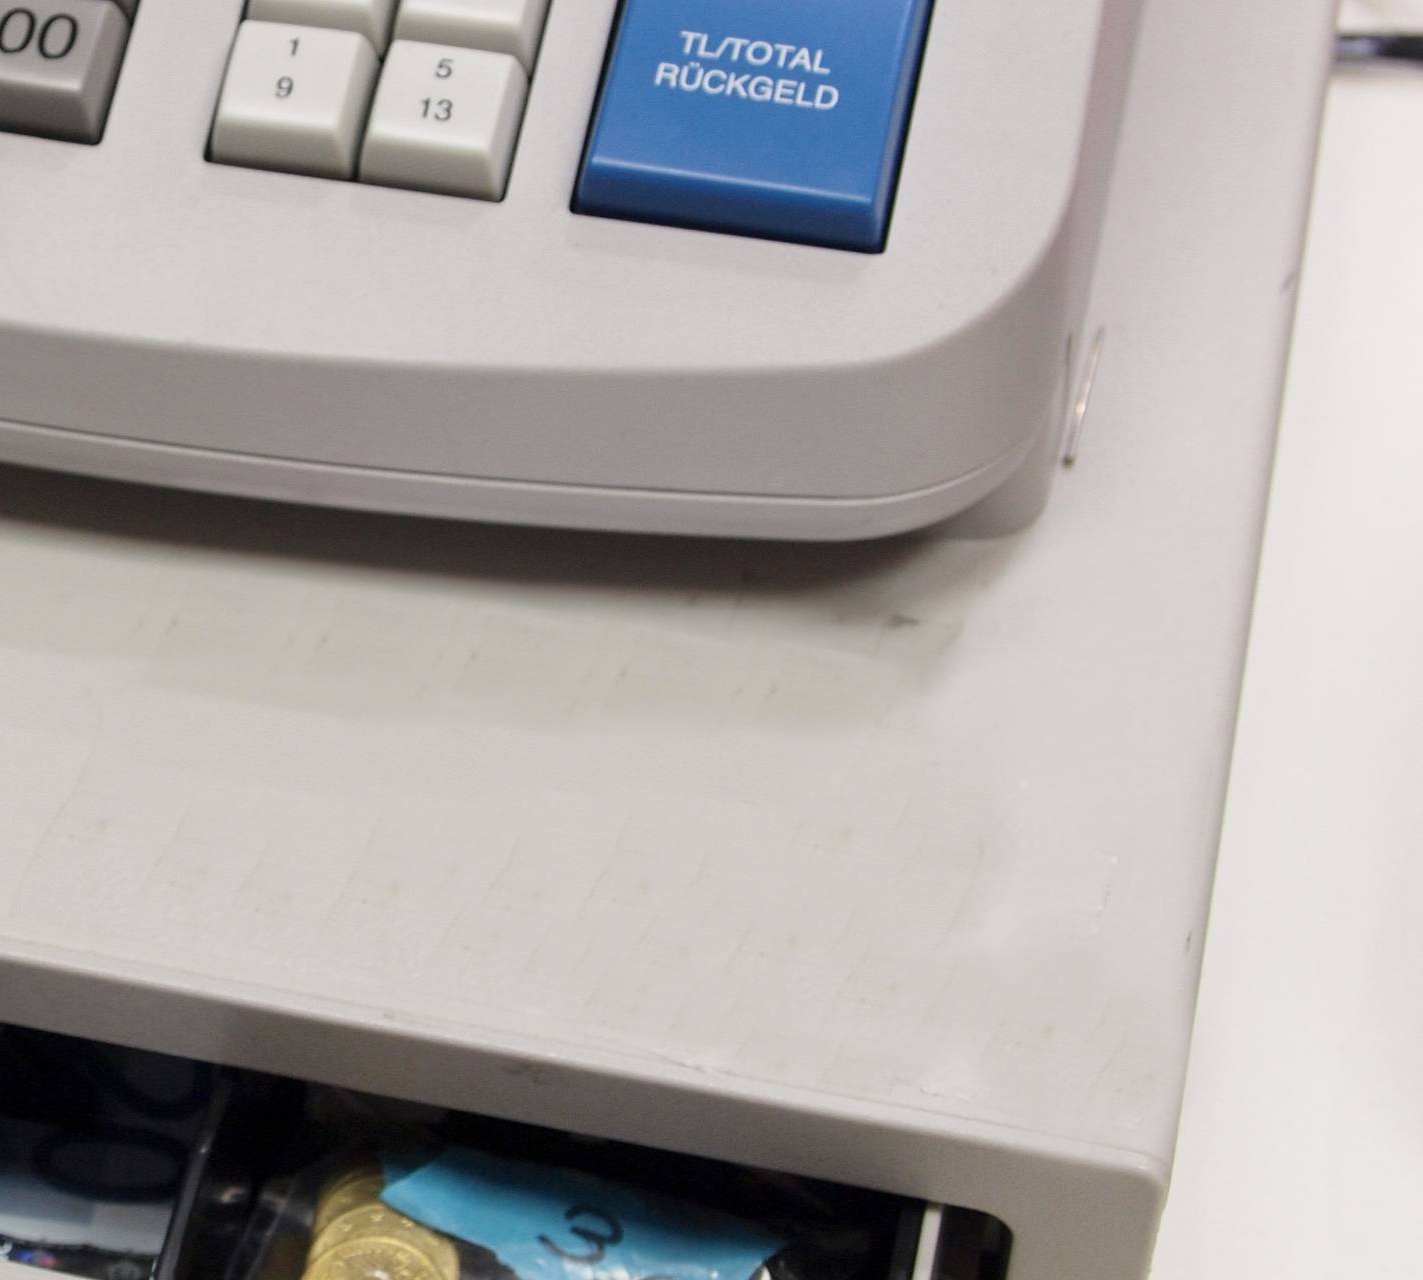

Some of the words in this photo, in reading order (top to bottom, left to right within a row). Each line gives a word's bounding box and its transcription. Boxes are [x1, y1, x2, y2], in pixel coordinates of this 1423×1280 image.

[288, 37, 301, 57] 1
[680, 29, 832, 76] TL/TOTAL
[434, 58, 455, 80] 5
[275, 76, 295, 100] 9
[653, 60, 840, 111] RÜCKGELD
[419, 97, 455, 123] 13
